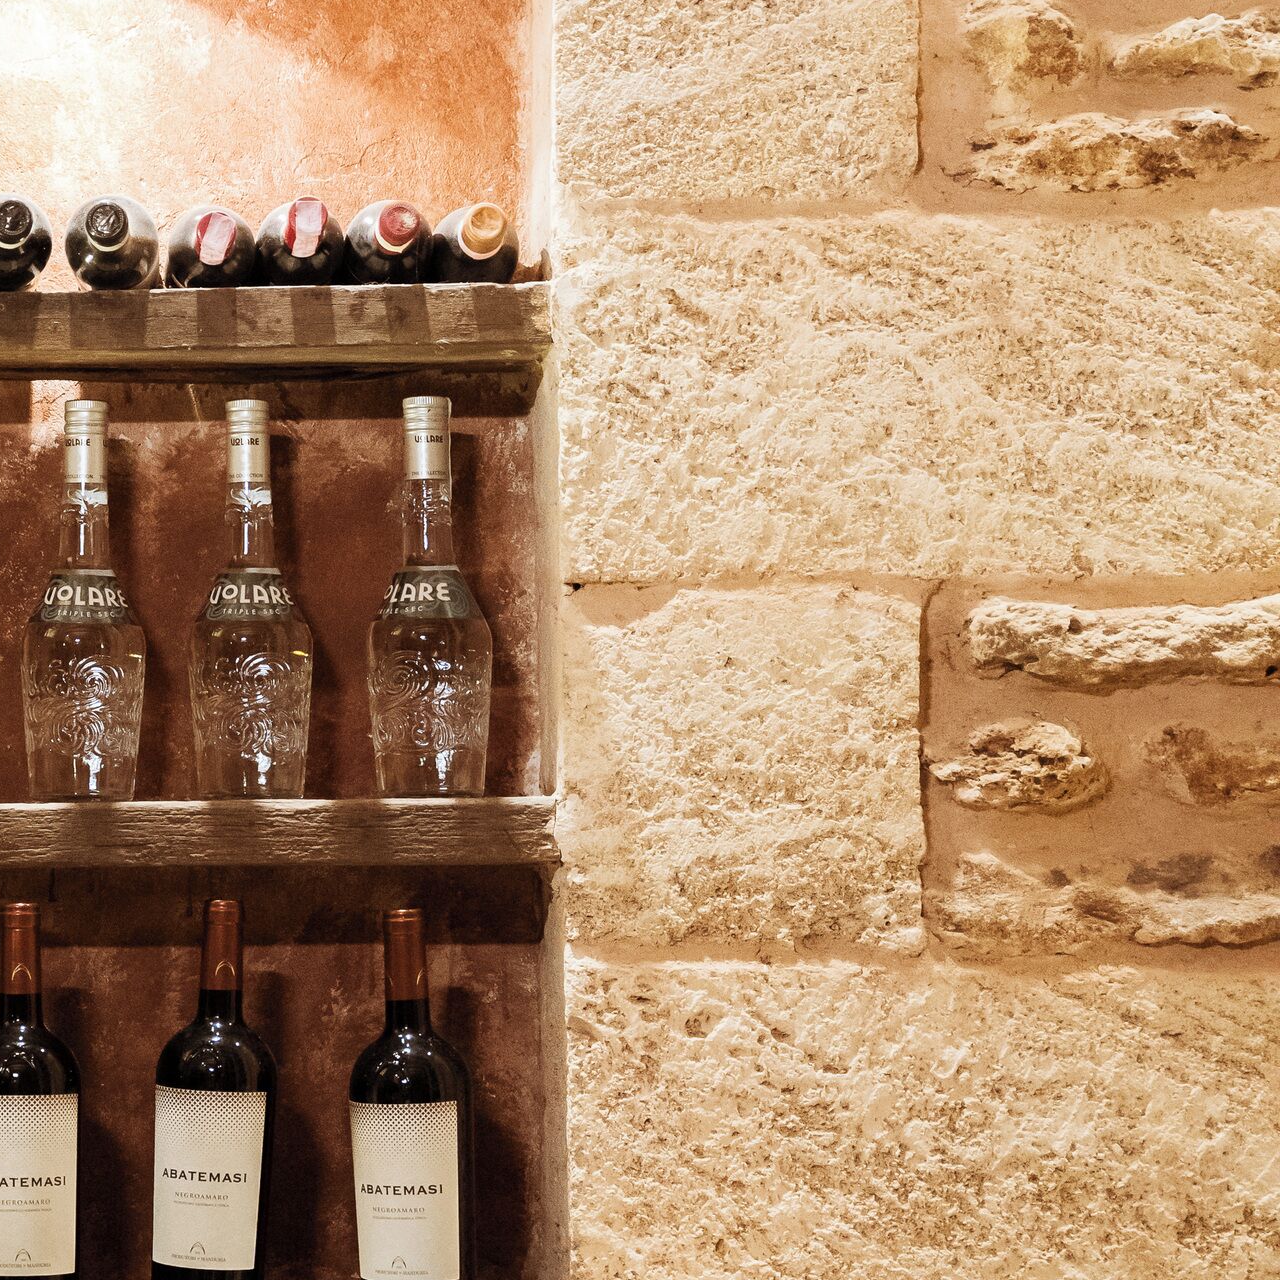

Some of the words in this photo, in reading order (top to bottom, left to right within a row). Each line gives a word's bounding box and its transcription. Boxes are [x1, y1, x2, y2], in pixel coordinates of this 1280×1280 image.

[384, 582, 451, 603] OLARE
[162, 1168, 247, 1183] ABATEMASI
[360, 1184, 443, 1196] ABATEMASI
